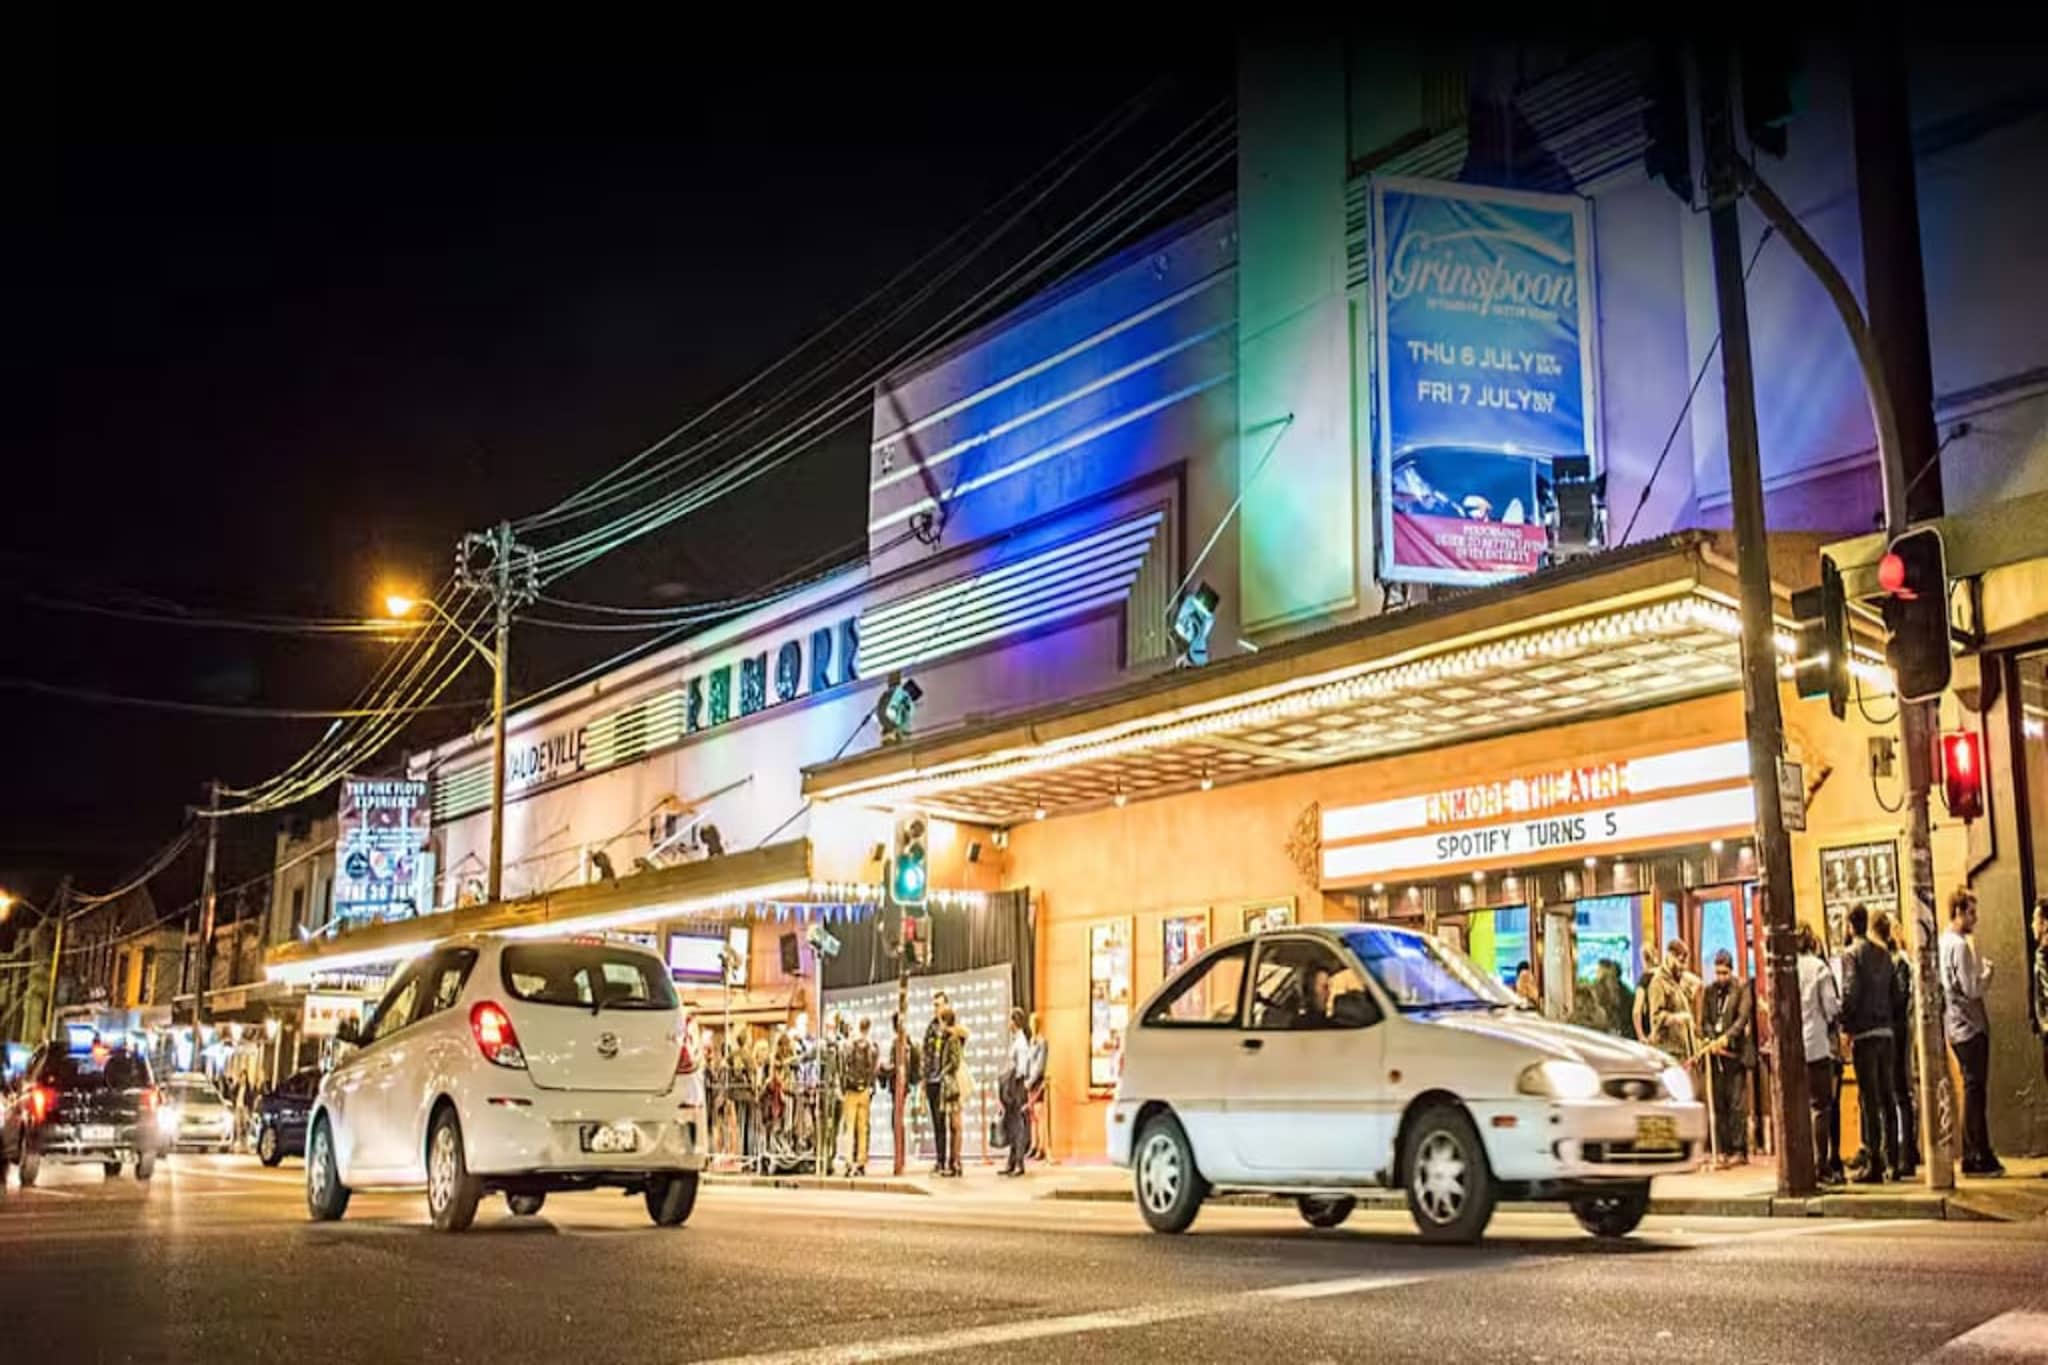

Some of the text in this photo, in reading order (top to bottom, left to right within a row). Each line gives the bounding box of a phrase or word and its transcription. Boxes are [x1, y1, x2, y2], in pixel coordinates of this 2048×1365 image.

[1388, 231, 1577, 316] Grinspoon
[1407, 341, 1456, 364] THU
[1480, 348, 1534, 373] JULY
[1418, 380, 1533, 411] FRI 7 JULY
[1426, 761, 1628, 824] ENMORE THEATRE
[1436, 812, 1618, 860] SPOTIFY TURNS 5
